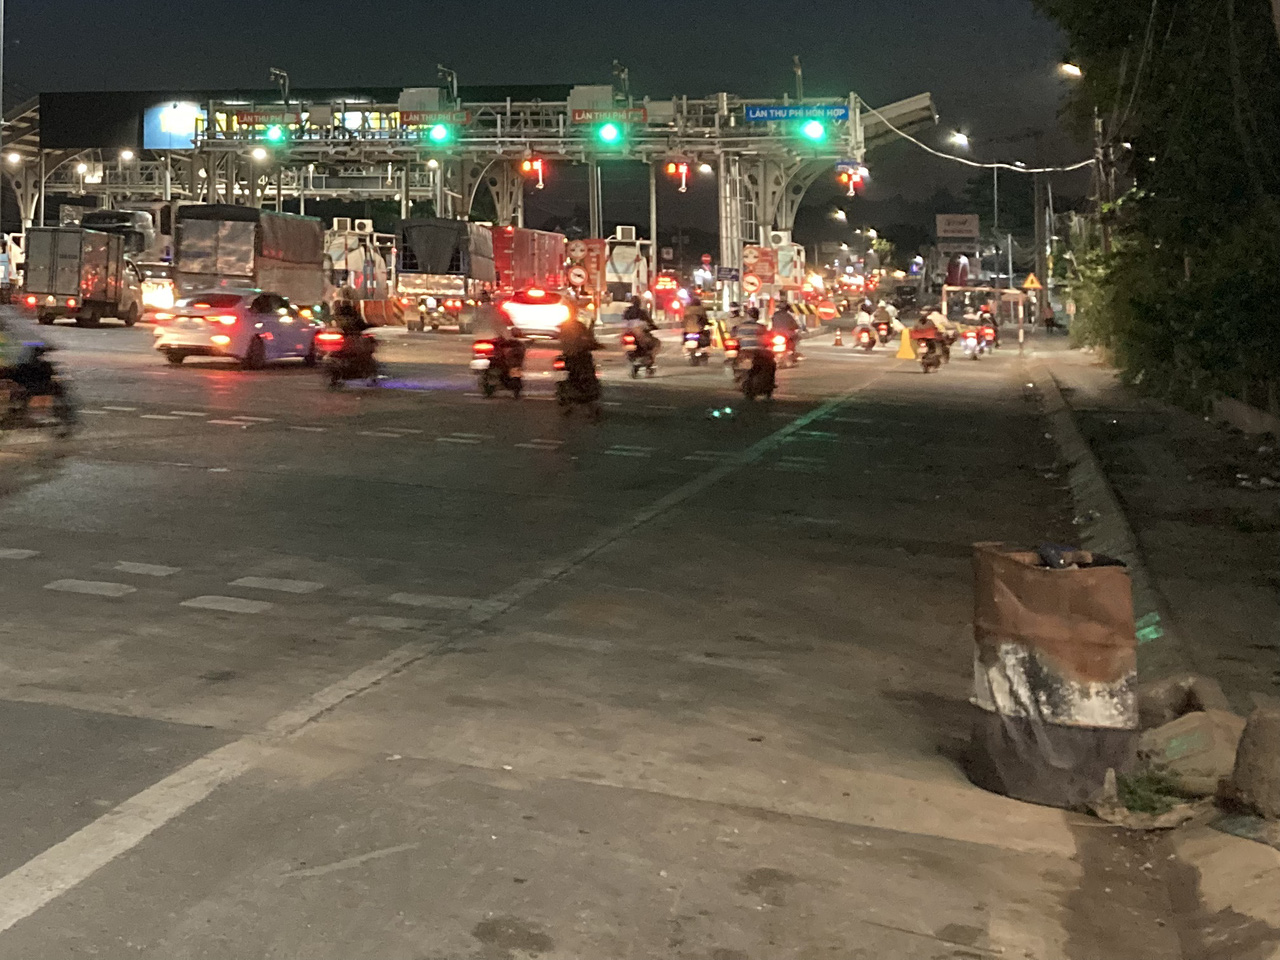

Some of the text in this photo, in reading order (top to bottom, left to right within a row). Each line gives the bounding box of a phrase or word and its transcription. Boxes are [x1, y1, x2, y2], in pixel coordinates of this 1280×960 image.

[403, 112, 419, 122] LÀN
[421, 113, 436, 122] THU
[574, 110, 627, 121] LÀN THU PHÍ
[749, 107, 767, 118] LÀN
[769, 109, 787, 118] THU
[788, 107, 804, 117] PHÍ
[238, 113, 253, 123] LÀN
[254, 114, 269, 123] THU
